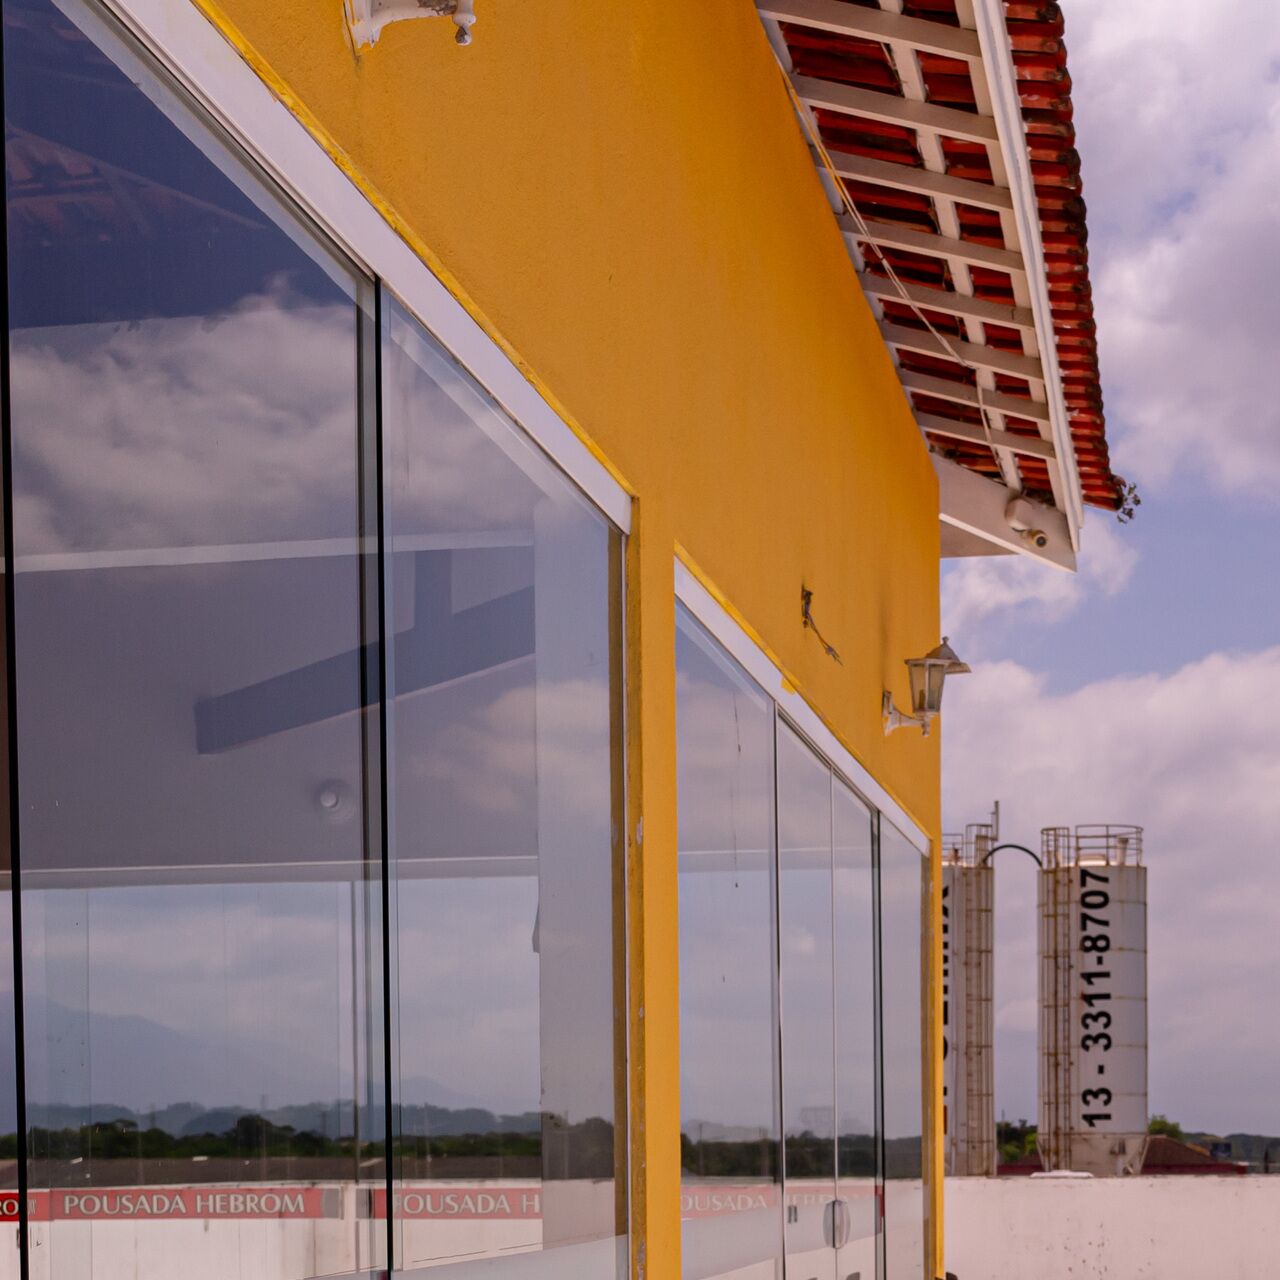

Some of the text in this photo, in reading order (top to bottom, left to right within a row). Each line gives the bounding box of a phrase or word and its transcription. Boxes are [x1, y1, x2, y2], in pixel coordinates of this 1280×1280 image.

[1080, 868, 1112, 1052] 3311-8707
[1081, 1087, 1112, 1127] 13
[64, 1192, 305, 1215] POUSADA HEBROM
[681, 1194, 768, 1211] OUSADA
